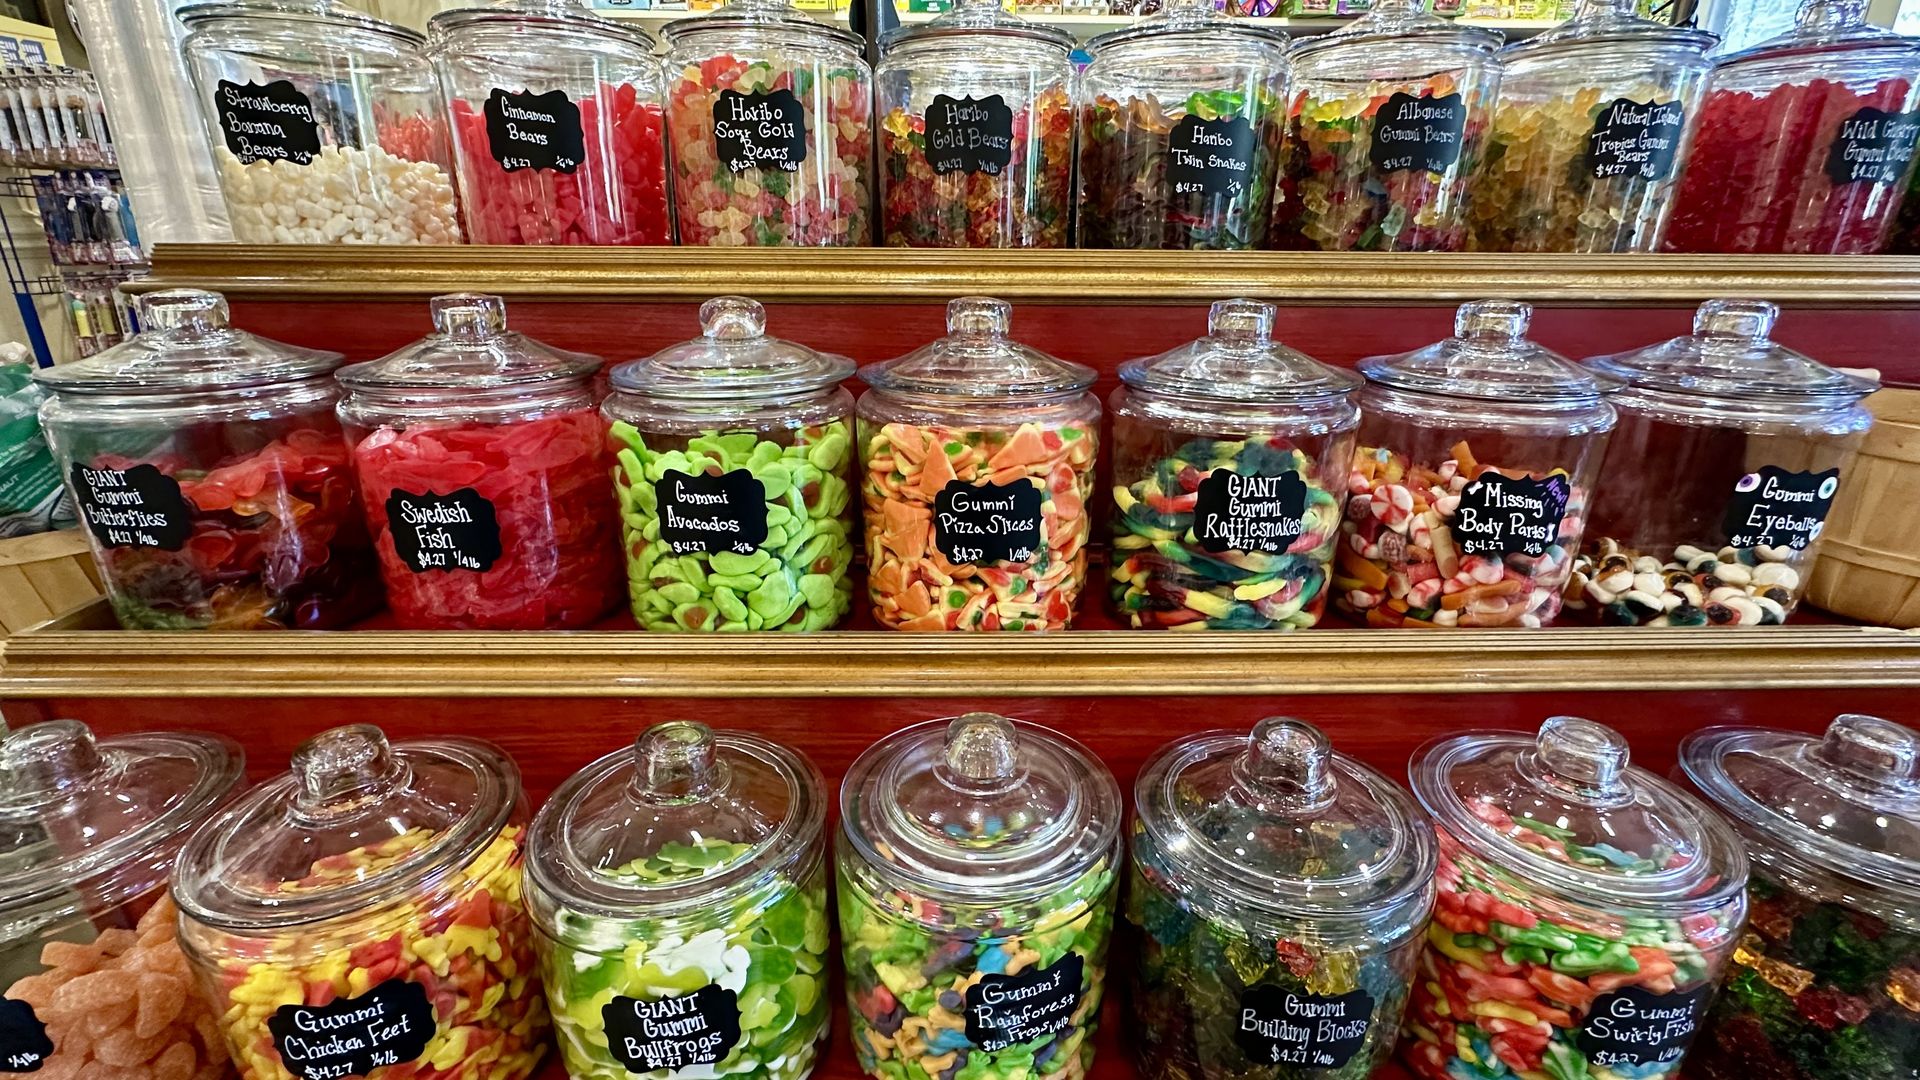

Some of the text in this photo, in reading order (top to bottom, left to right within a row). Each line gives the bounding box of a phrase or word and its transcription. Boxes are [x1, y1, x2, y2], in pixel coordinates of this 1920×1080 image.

[224, 86, 313, 123] Strawberry
[501, 96, 556, 124] Cinnamon
[728, 97, 783, 121] Haribo
[945, 104, 989, 125] Haribo
[1396, 102, 1453, 120] Albanese
[1607, 103, 1683, 126] Natural Island
[226, 112, 287, 138] Banana
[506, 123, 548, 146] Bears
[715, 121, 795, 141] Sour Gold
[1191, 126, 1233, 147] Haribo
[1380, 126, 1420, 143] Gummi
[1841, 120, 1879, 139] Wild
[238, 136, 289, 156] Bears
[741, 137, 789, 159] Bears
[932, 128, 1009, 150] Gold Bears
[1592, 129, 1671, 155] Tropics Gummi
[1171, 148, 1247, 170] Twin Snakes
[1617, 151, 1651, 162] Bears
[1595, 164, 1627, 178] $4.27
[82, 468, 128, 487] GIANT
[1227, 474, 1282, 499] GIANT
[1762, 476, 1815, 502] Gummi
[91, 487, 144, 506] Gummi
[676, 480, 730, 505] Gummi
[951, 492, 1016, 512] Gummi
[1484, 482, 1542, 519] Missing
[86, 503, 168, 527] Butterflies
[401, 500, 473, 523] Swedish
[666, 505, 741, 533] Avocados
[1228, 498, 1282, 518] Gummi
[1746, 504, 1817, 535] Eyeballs
[939, 513, 1034, 535] Pizza Slices
[1204, 513, 1301, 538] Rattlesnakes
[1459, 507, 1503, 540] Body
[415, 524, 456, 549] Fish
[673, 541, 706, 554] $4.27
[1465, 540, 1503, 553] $4.27
[1731, 534, 1773, 547] $4.27
[418, 550, 446, 569] $4.27
[981, 970, 1061, 1004] Gummi
[294, 997, 385, 1033] Gummi
[633, 993, 699, 1019] GIANT
[974, 994, 1075, 1029] Rainforest
[1284, 994, 1346, 1017] Gummi
[1610, 998, 1696, 1019] Gummi
[284, 1013, 412, 1060] Chicken Feet
[642, 1012, 709, 1039] Gummi
[1007, 1019, 1051, 1044] Frogs
[1241, 1009, 1369, 1050] Building Blocks
[1585, 1016, 1695, 1047] Swirly Fish
[624, 1031, 722, 1060] Bullfrogs
[1270, 1044, 1307, 1063] $4.27
